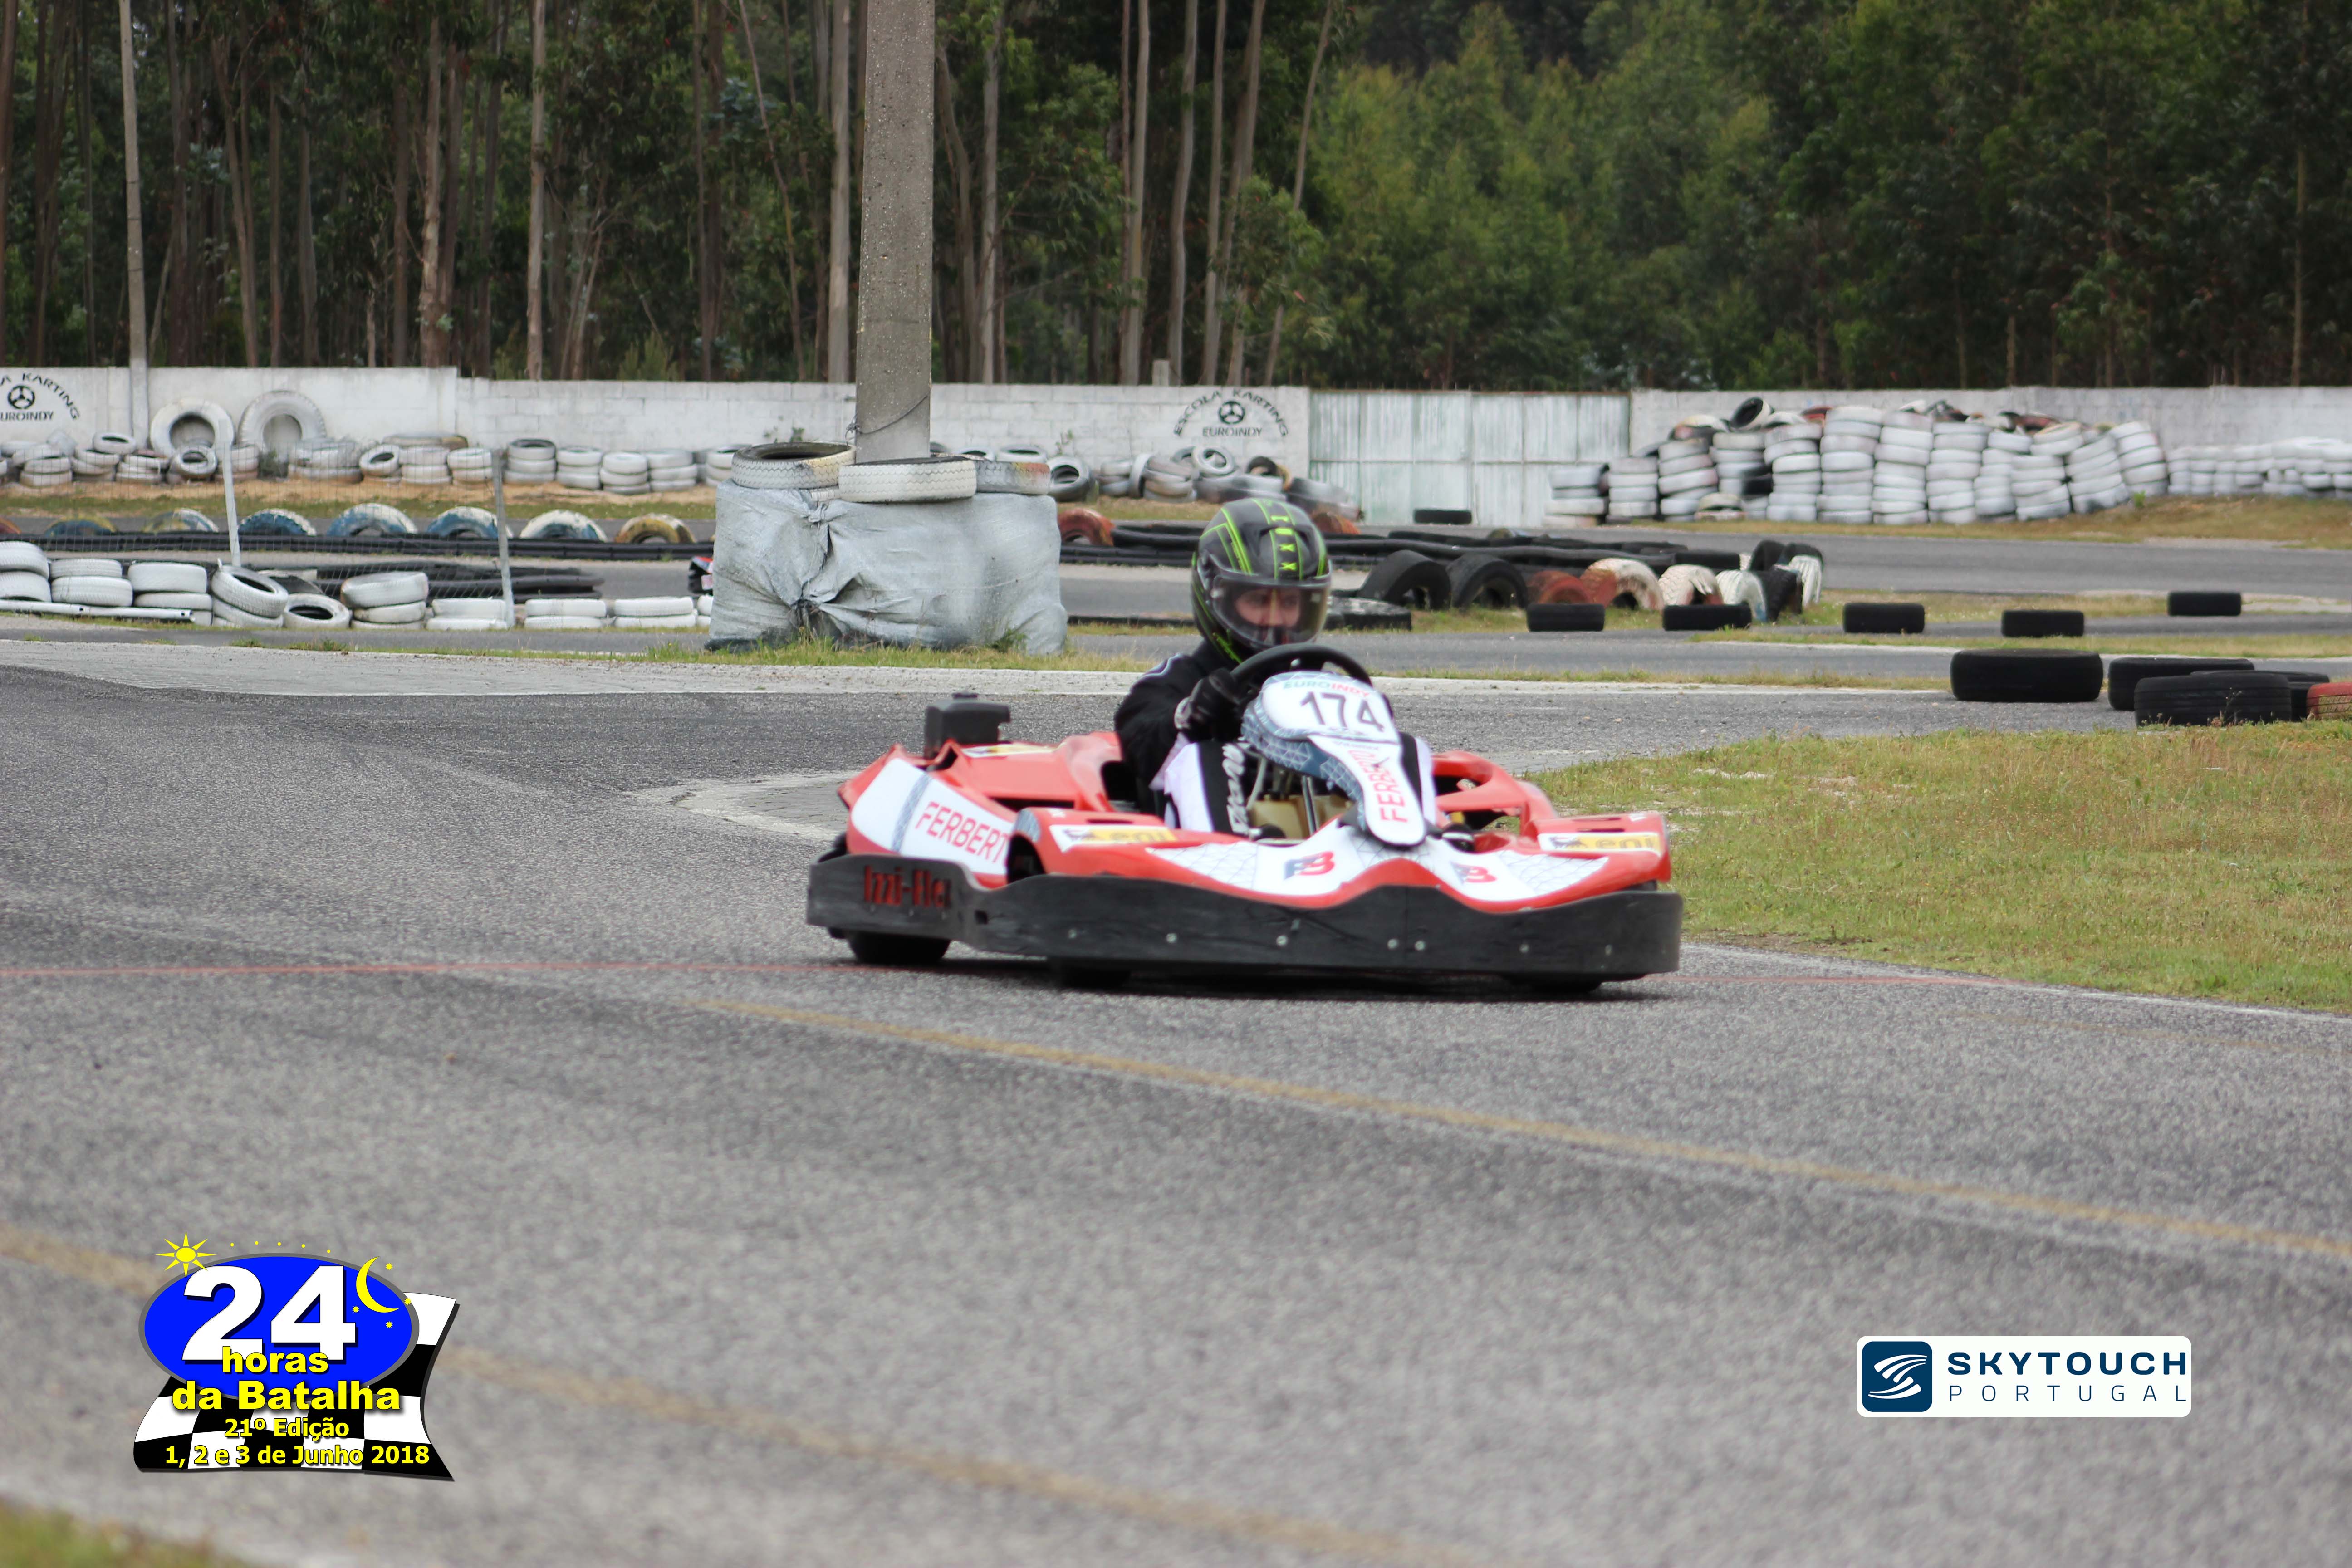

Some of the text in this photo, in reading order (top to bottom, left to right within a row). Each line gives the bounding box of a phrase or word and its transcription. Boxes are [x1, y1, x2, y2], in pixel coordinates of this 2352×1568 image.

[22, 372, 81, 420] KARTING
[0, 410, 54, 421] UROINDY
[1173, 388, 1289, 437] ESCOLA KARTING
[1202, 426, 1263, 436] EUROINDY
[1299, 691, 1385, 733] 174
[1595, 834, 1654, 849] eni
